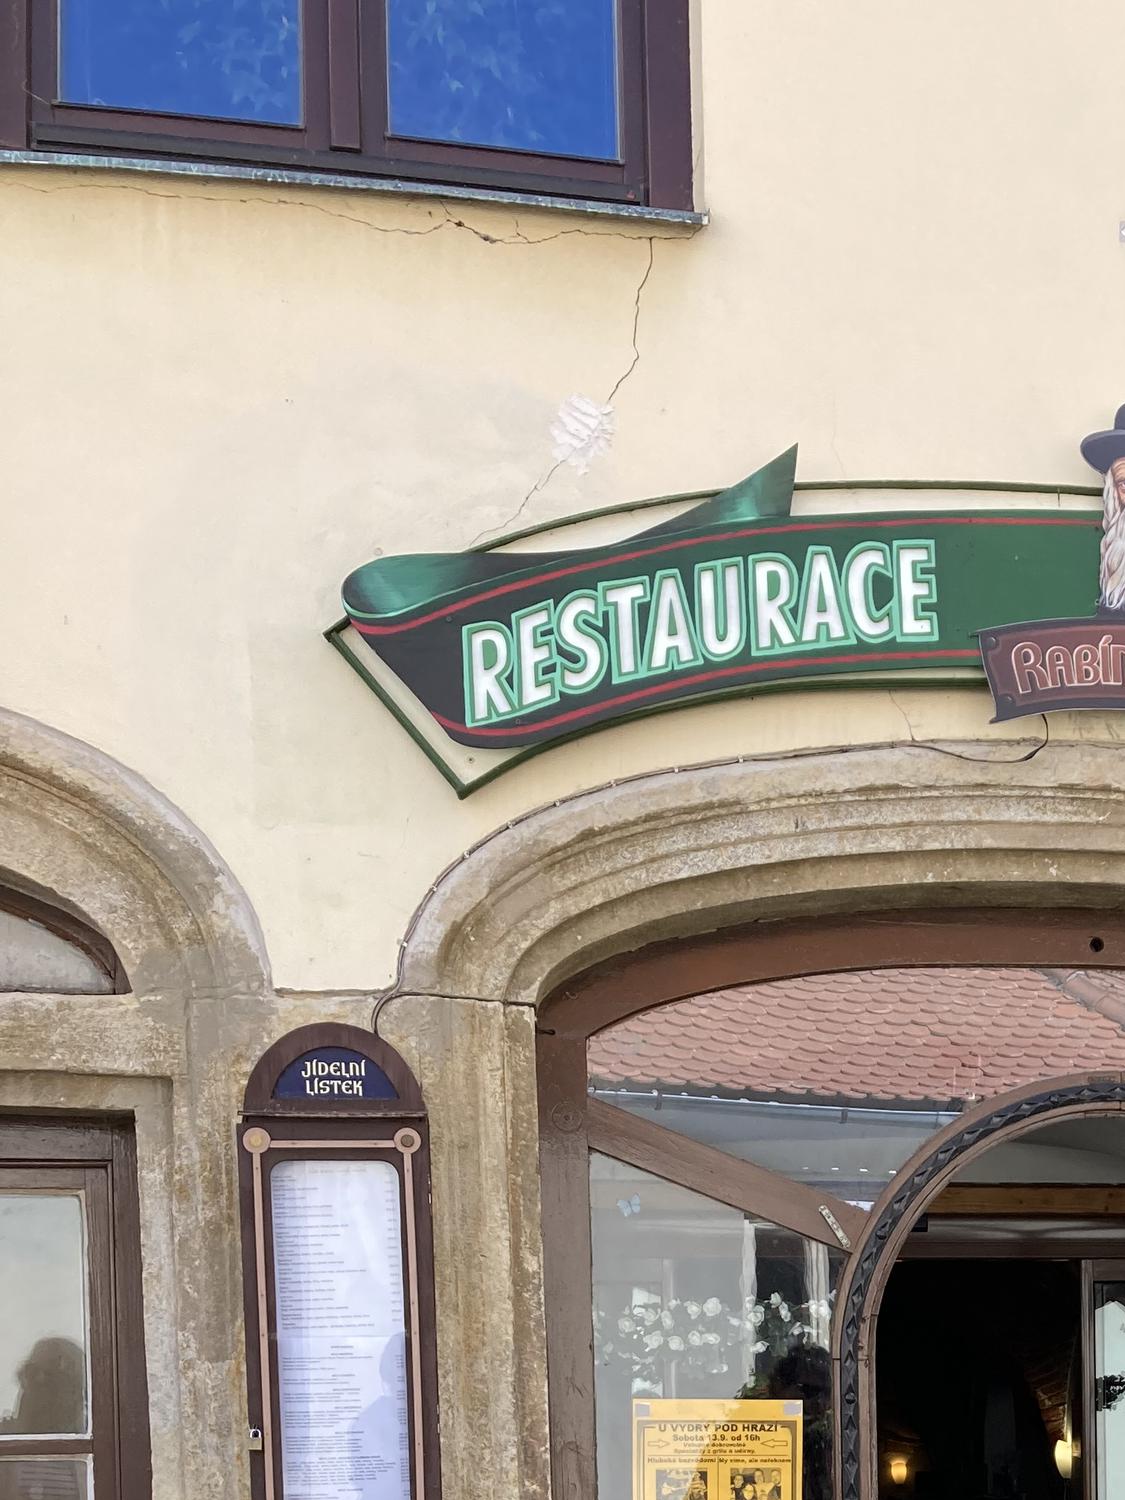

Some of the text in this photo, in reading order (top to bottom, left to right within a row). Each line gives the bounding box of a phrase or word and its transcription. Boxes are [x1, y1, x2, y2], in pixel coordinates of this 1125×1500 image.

[462, 538, 939, 728] RESTAURACE
[301, 1058, 366, 1078] JÍDELNÍ
[305, 1077, 363, 1096] LÍSTEK
[670, 1424, 710, 1432] VYDRY
[715, 1424, 738, 1432] POD
[731, 1433, 741, 1441] od
[744, 1433, 760, 1441] 16h
